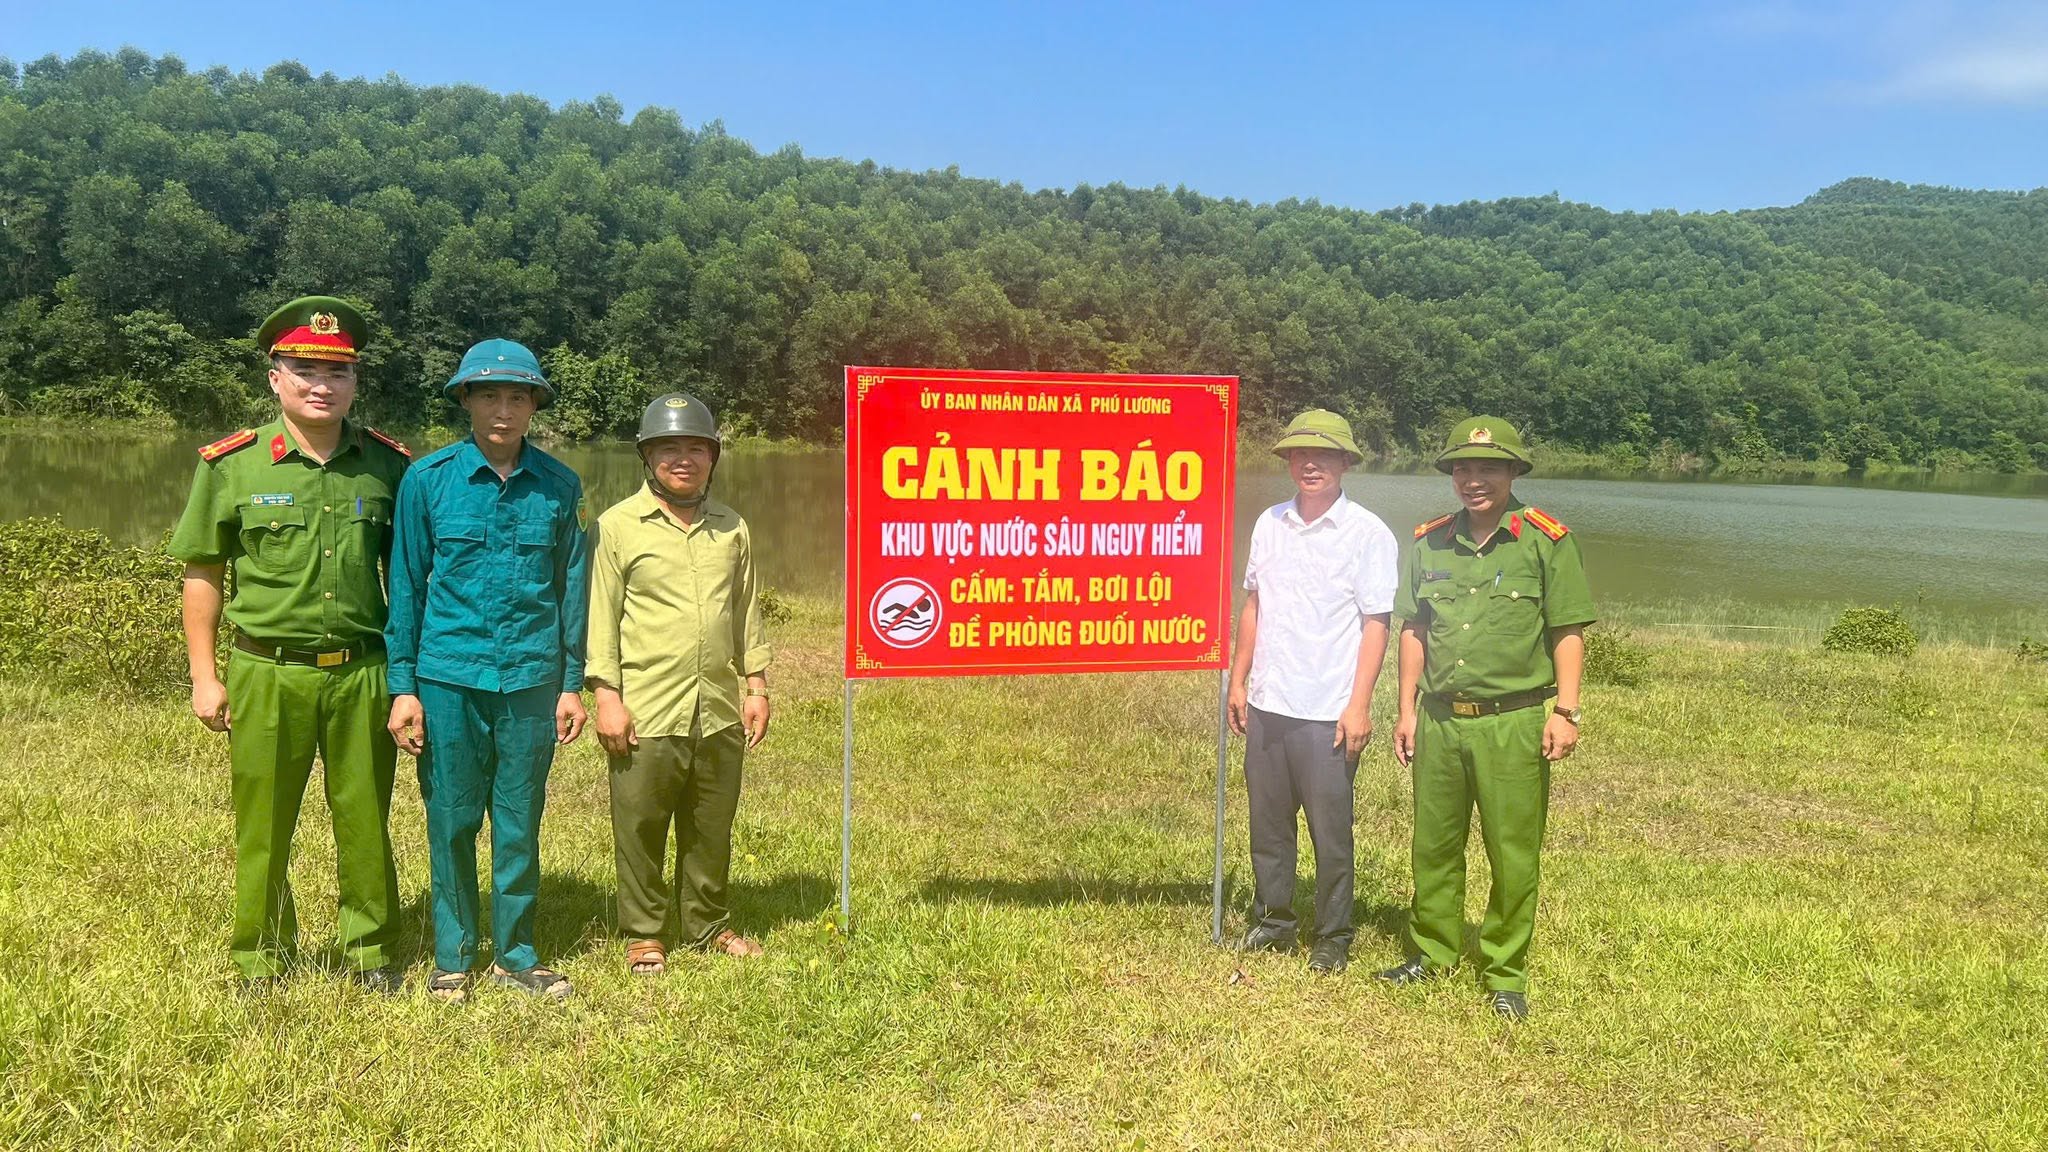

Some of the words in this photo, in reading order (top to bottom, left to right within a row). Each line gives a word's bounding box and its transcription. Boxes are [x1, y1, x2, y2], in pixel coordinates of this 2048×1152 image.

[920, 387, 940, 408] ỦY
[945, 392, 976, 410] BAN
[980, 391, 1023, 411] NHÂN
[1027, 392, 1058, 412] DÂN
[1062, 393, 1082, 412] XÃ
[1090, 394, 1119, 413] PHÚ
[1123, 396, 1171, 414] LƯƠNG
[883, 431, 1060, 500] CẢNH
[1080, 439, 1202, 501] BÁO
[882, 522, 925, 556] KHU
[932, 519, 973, 563] VỰC
[980, 515, 1037, 556] NƯỚC
[1044, 515, 1085, 556] SÂU
[1092, 522, 1146, 556] NGUY
[1152, 509, 1202, 555] HIỂM
[951, 568, 1014, 603] CẤM:
[1022, 567, 1080, 605] TẮM,
[1089, 574, 1128, 602] BƠI
[1136, 571, 1171, 606] LỘI
[949, 613, 980, 647] ĐỀ
[989, 615, 1071, 646] PHÒNG
[1079, 610, 1134, 645] ĐUỐI
[1143, 613, 1206, 644] NƯỚC
